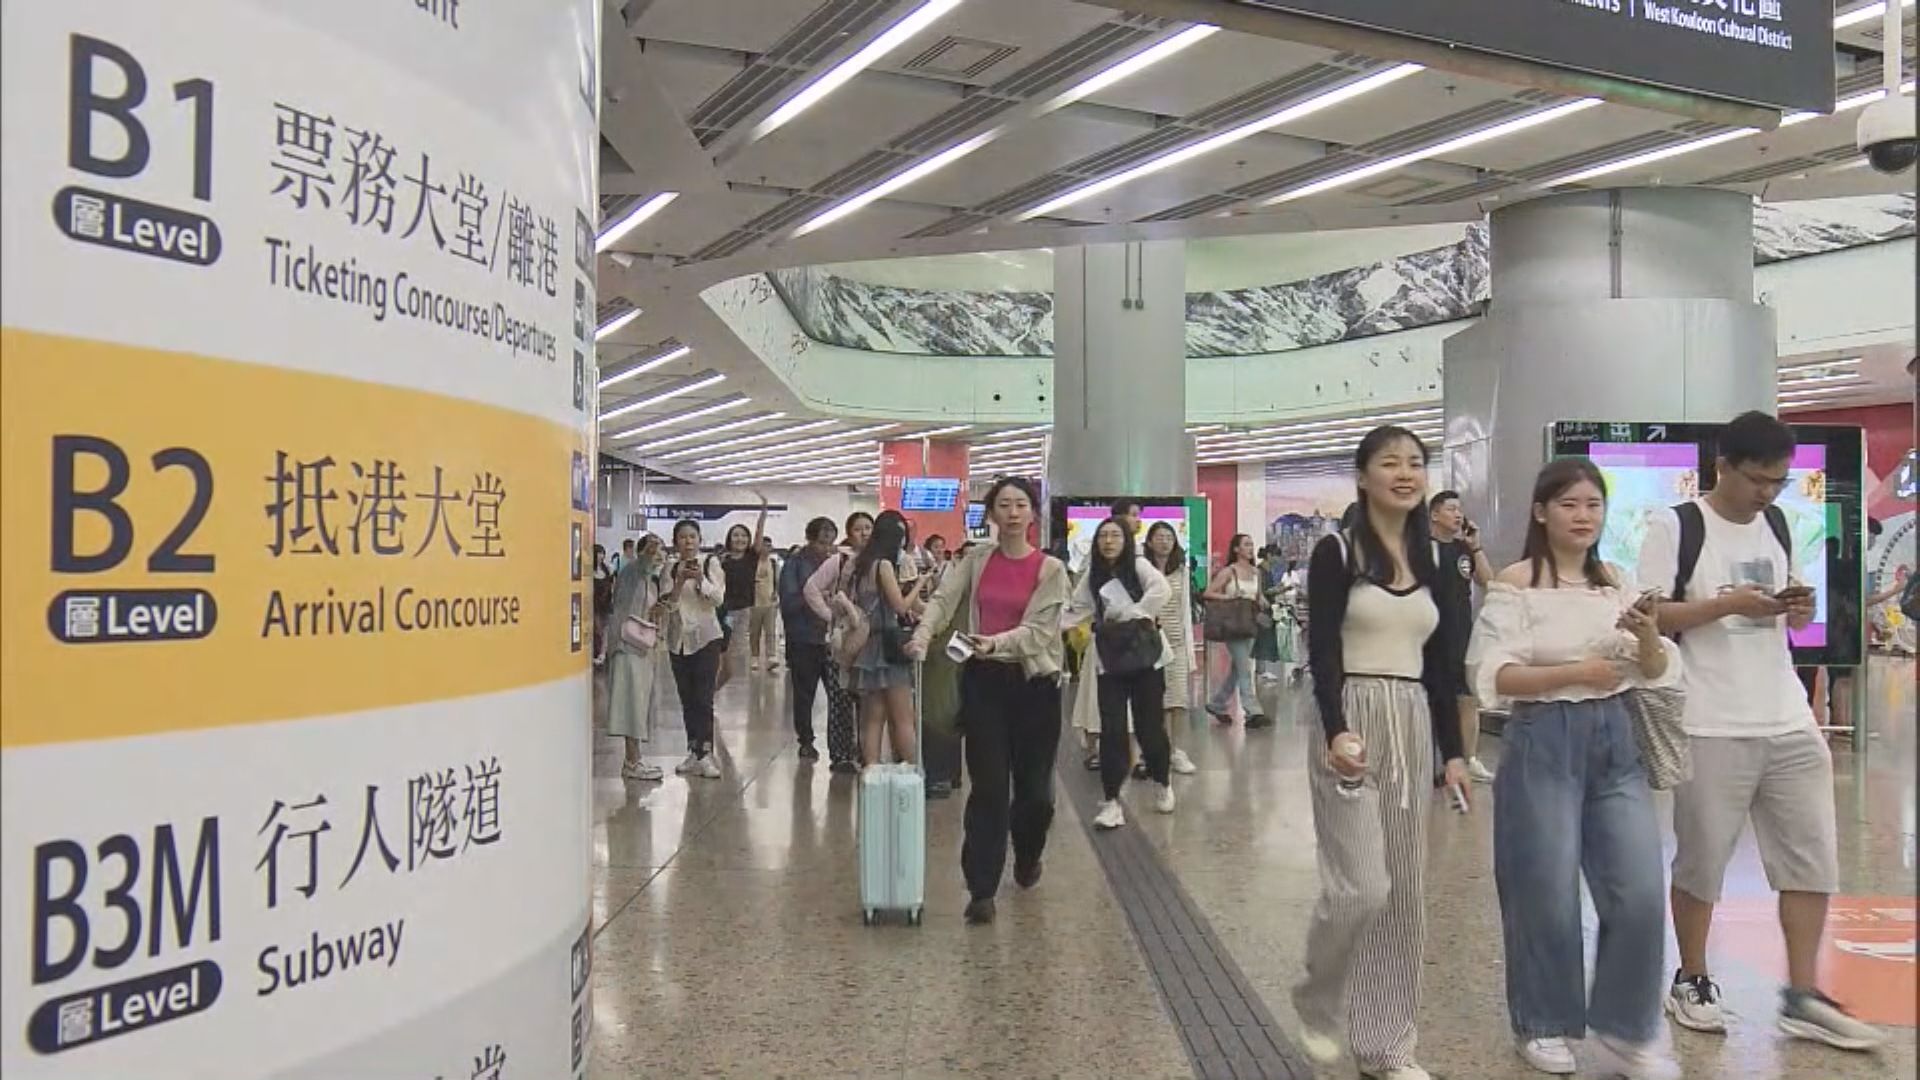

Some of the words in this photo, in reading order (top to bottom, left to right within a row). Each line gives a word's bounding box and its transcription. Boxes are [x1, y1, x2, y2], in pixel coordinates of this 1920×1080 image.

[1643, 3, 1671, 25] West
[1717, 18, 1757, 43] Cultural
[1757, 26, 1793, 50] District
[68, 32, 214, 201] B1
[71, 194, 105, 238] 層
[112, 203, 209, 259] Level
[270, 101, 558, 298] 票務大堂/離港
[265, 236, 387, 321] Ticketing
[50, 434, 215, 573] B2
[264, 450, 507, 558] 抵港大堂
[65, 596, 99, 637] 層
[107, 593, 204, 636] Level
[261, 586, 385, 638] Arrival
[395, 588, 521, 631] Concourse
[255, 756, 502, 909] 行人隧道
[31, 816, 221, 986] B3M
[257, 918, 404, 996] Subway
[57, 997, 94, 1046] 層
[100, 968, 199, 1032] Level
